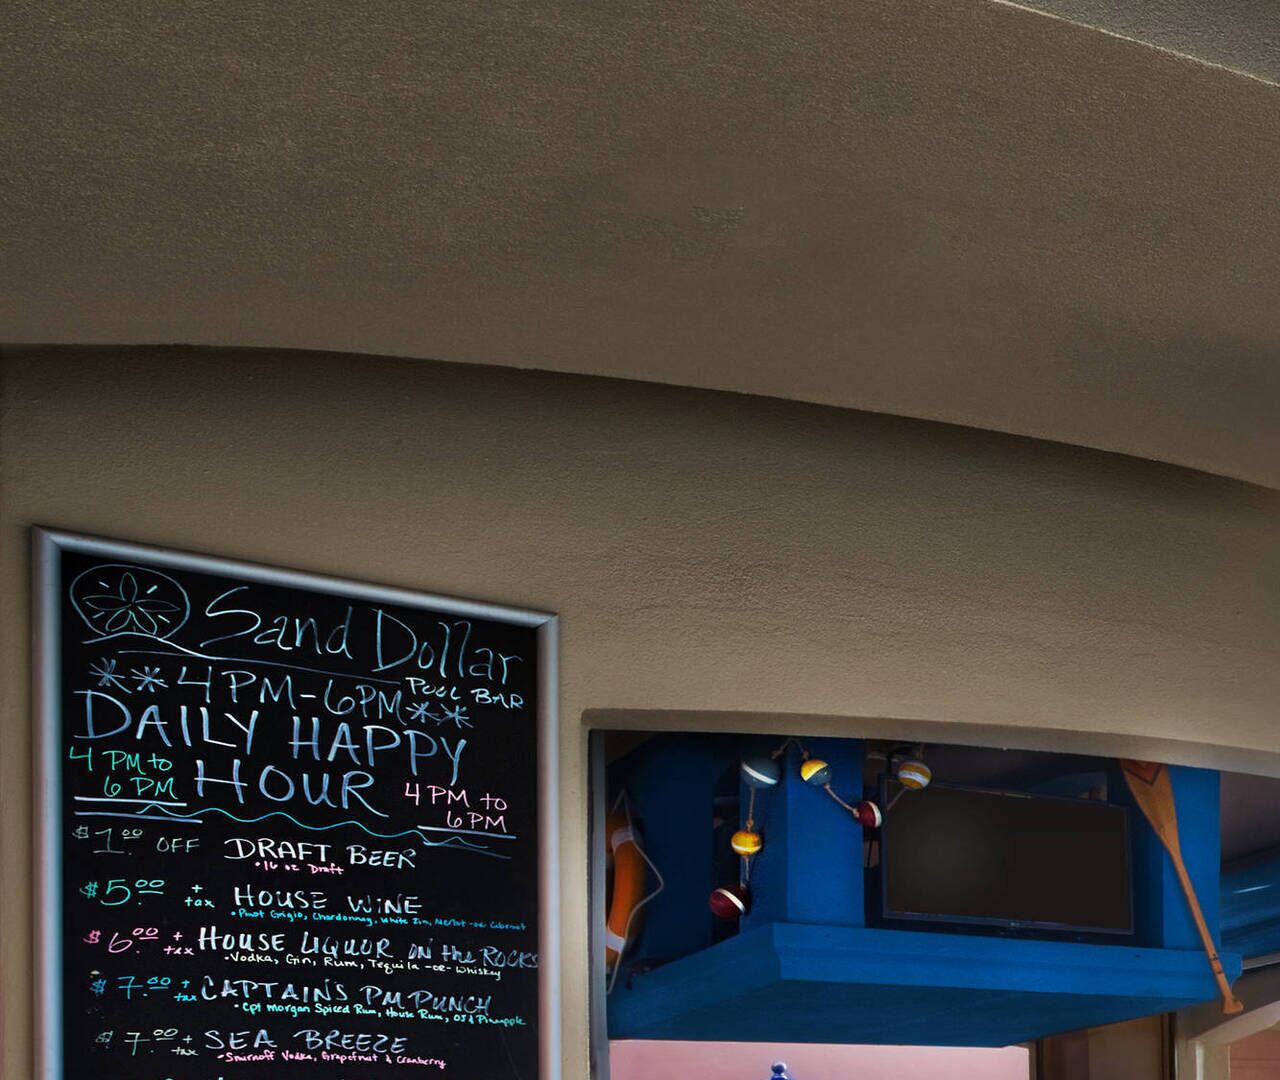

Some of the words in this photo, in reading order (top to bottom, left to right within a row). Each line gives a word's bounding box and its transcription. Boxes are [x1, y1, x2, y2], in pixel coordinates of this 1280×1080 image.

[200, 585, 353, 660] Sand
[370, 607, 524, 685] Dollar
[405, 677, 461, 700] POOL
[470, 687, 524, 710] BAR
[73, 689, 259, 756] DAILY
[288, 715, 467, 787] HAPPY
[194, 758, 390, 818] HOUR
[480, 793, 508, 811] to
[156, 836, 200, 853] OFF
[224, 838, 331, 862] DRAFT
[346, 844, 416, 869] BEER
[307, 863, 344, 875] Draft
[184, 896, 215, 908] tax
[234, 884, 328, 909] HOUSE
[164, 945, 195, 956] tax
[198, 926, 285, 952] HOUSE
[301, 931, 394, 959] LIQUOR
[441, 944, 476, 963] the
[480, 946, 539, 968] ROCKS
[230, 951, 279, 965] Vodka,
[286, 953, 316, 966] Gin,
[324, 956, 364, 970] Rum,
[367, 958, 420, 975] Tequila
[174, 993, 198, 1002] tax
[315, 1003, 350, 1015] Spiced
[360, 985, 405, 1010] PM
[407, 990, 492, 1016] PUNCH
[170, 1046, 199, 1056] tax
[204, 1029, 278, 1050] SEA
[293, 1029, 408, 1053] BREEZE
